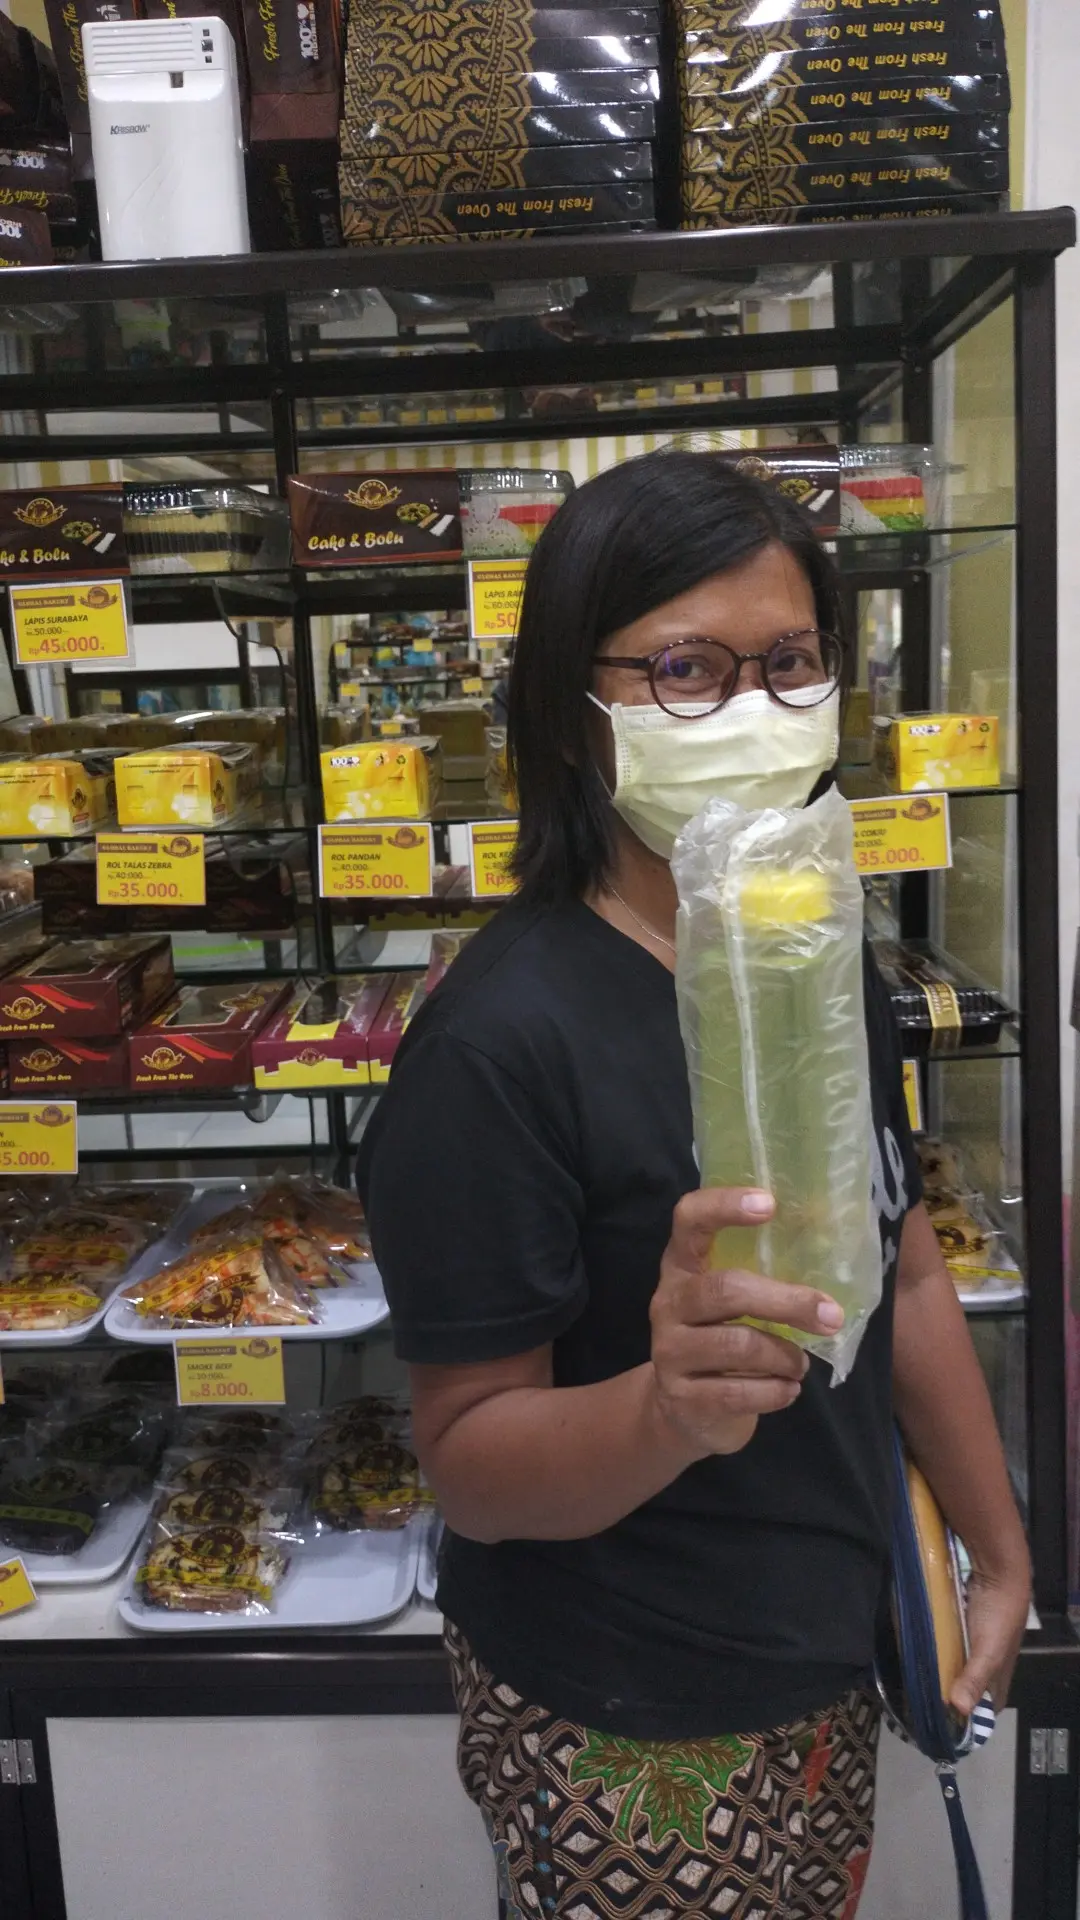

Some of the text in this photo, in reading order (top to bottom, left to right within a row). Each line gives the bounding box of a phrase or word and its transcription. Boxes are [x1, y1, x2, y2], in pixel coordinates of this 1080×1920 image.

[62, 2, 79, 26] The
[805, 20, 946, 39] Fresh From The Oven
[263, 21, 280, 61] Fresh
[807, 52, 947, 72] Fresh From The Oven
[811, 86, 951, 108] Fresh From The Oven
[110, 124, 149, 135] KRISBOW
[808, 125, 951, 148] Fresh From The Oven
[811, 166, 951, 188] Fresh From The Oven
[457, 196, 593, 218] Fresh From The Oven
[308, 531, 404, 551] Cake & Bolu
[19, 548, 30, 564] &
[33, 547, 71, 565] Bolu
[484, 591, 505, 599] LAPIS
[24, 614, 89, 626] LAPIS SURABAYA
[106, 861, 172, 869] ROL TALAS ZEBRA
[347, 853, 381, 861] PANDAN
[482, 852, 497, 860] ROL
